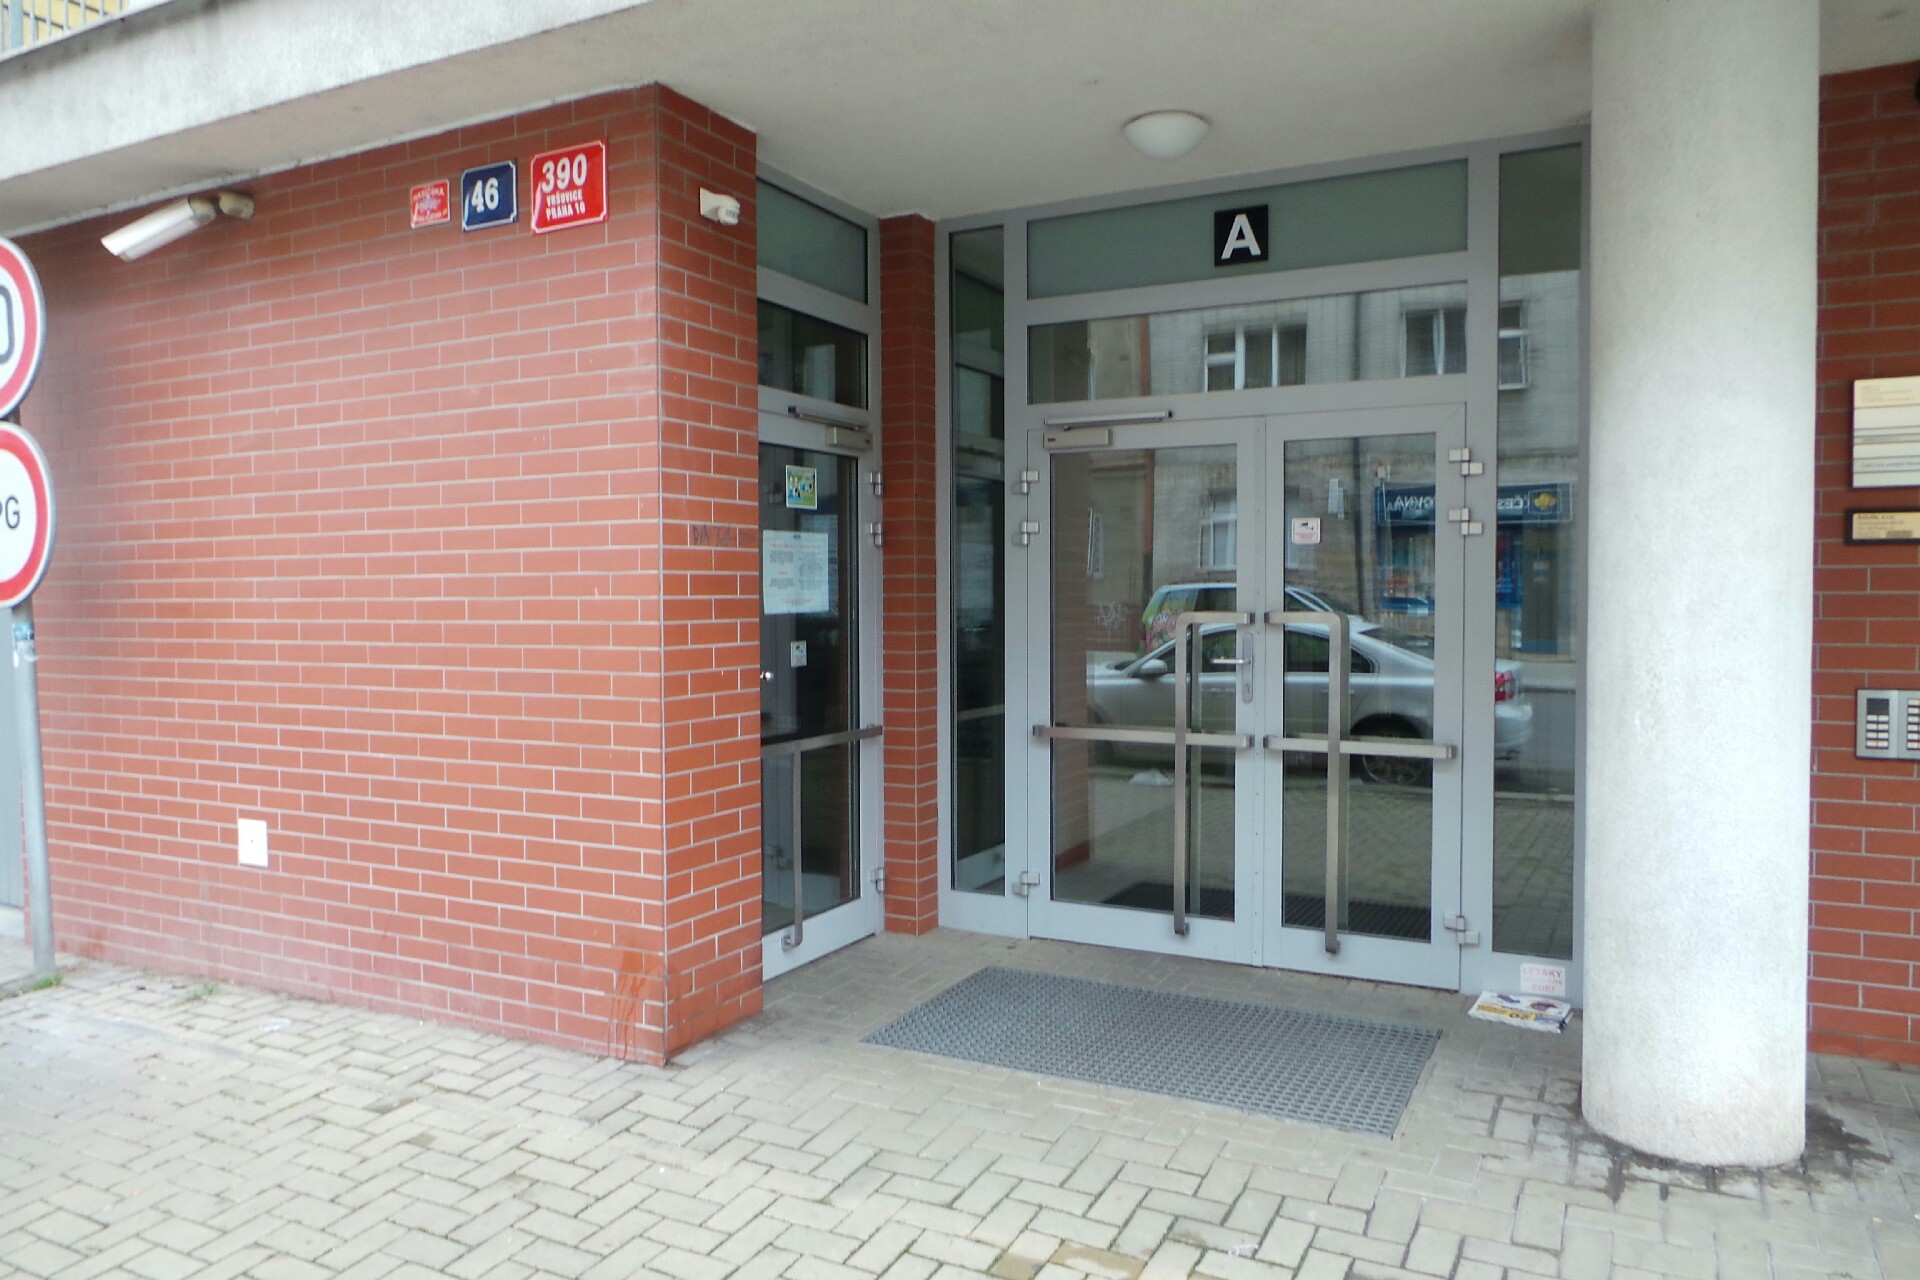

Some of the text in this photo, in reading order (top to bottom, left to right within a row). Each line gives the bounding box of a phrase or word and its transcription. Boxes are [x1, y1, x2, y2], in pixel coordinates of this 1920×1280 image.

[542, 153, 588, 193] 390
[471, 177, 499, 213] 46
[545, 200, 586, 221] PRAHA 10
[546, 188, 583, 207] VRŠOVICE
[1221, 213, 1262, 260] A
[0, 495, 20, 529] G
